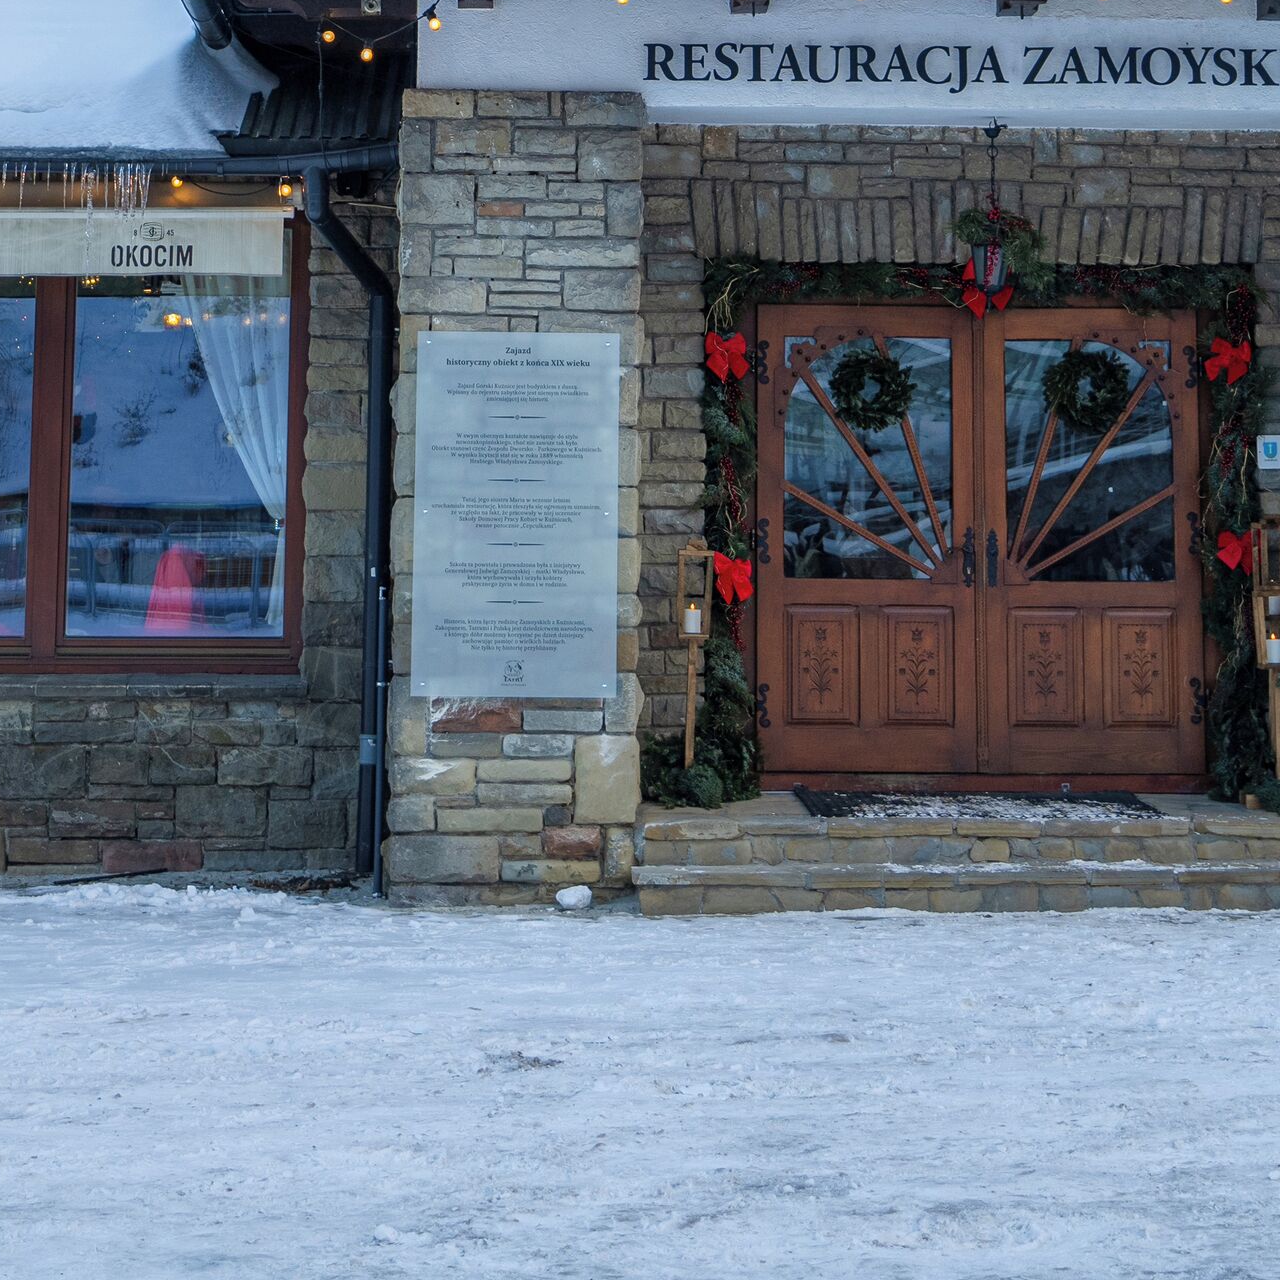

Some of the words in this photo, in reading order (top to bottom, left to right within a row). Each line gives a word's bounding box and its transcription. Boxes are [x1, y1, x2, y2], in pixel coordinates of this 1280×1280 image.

[644, 42, 1010, 94] RESTAURACJA
[166, 229, 175, 237] 45
[111, 244, 194, 267] OKOCIM
[505, 347, 532, 355] Zajazd
[446, 358, 491, 367] historyczny
[526, 359, 550, 367] końca
